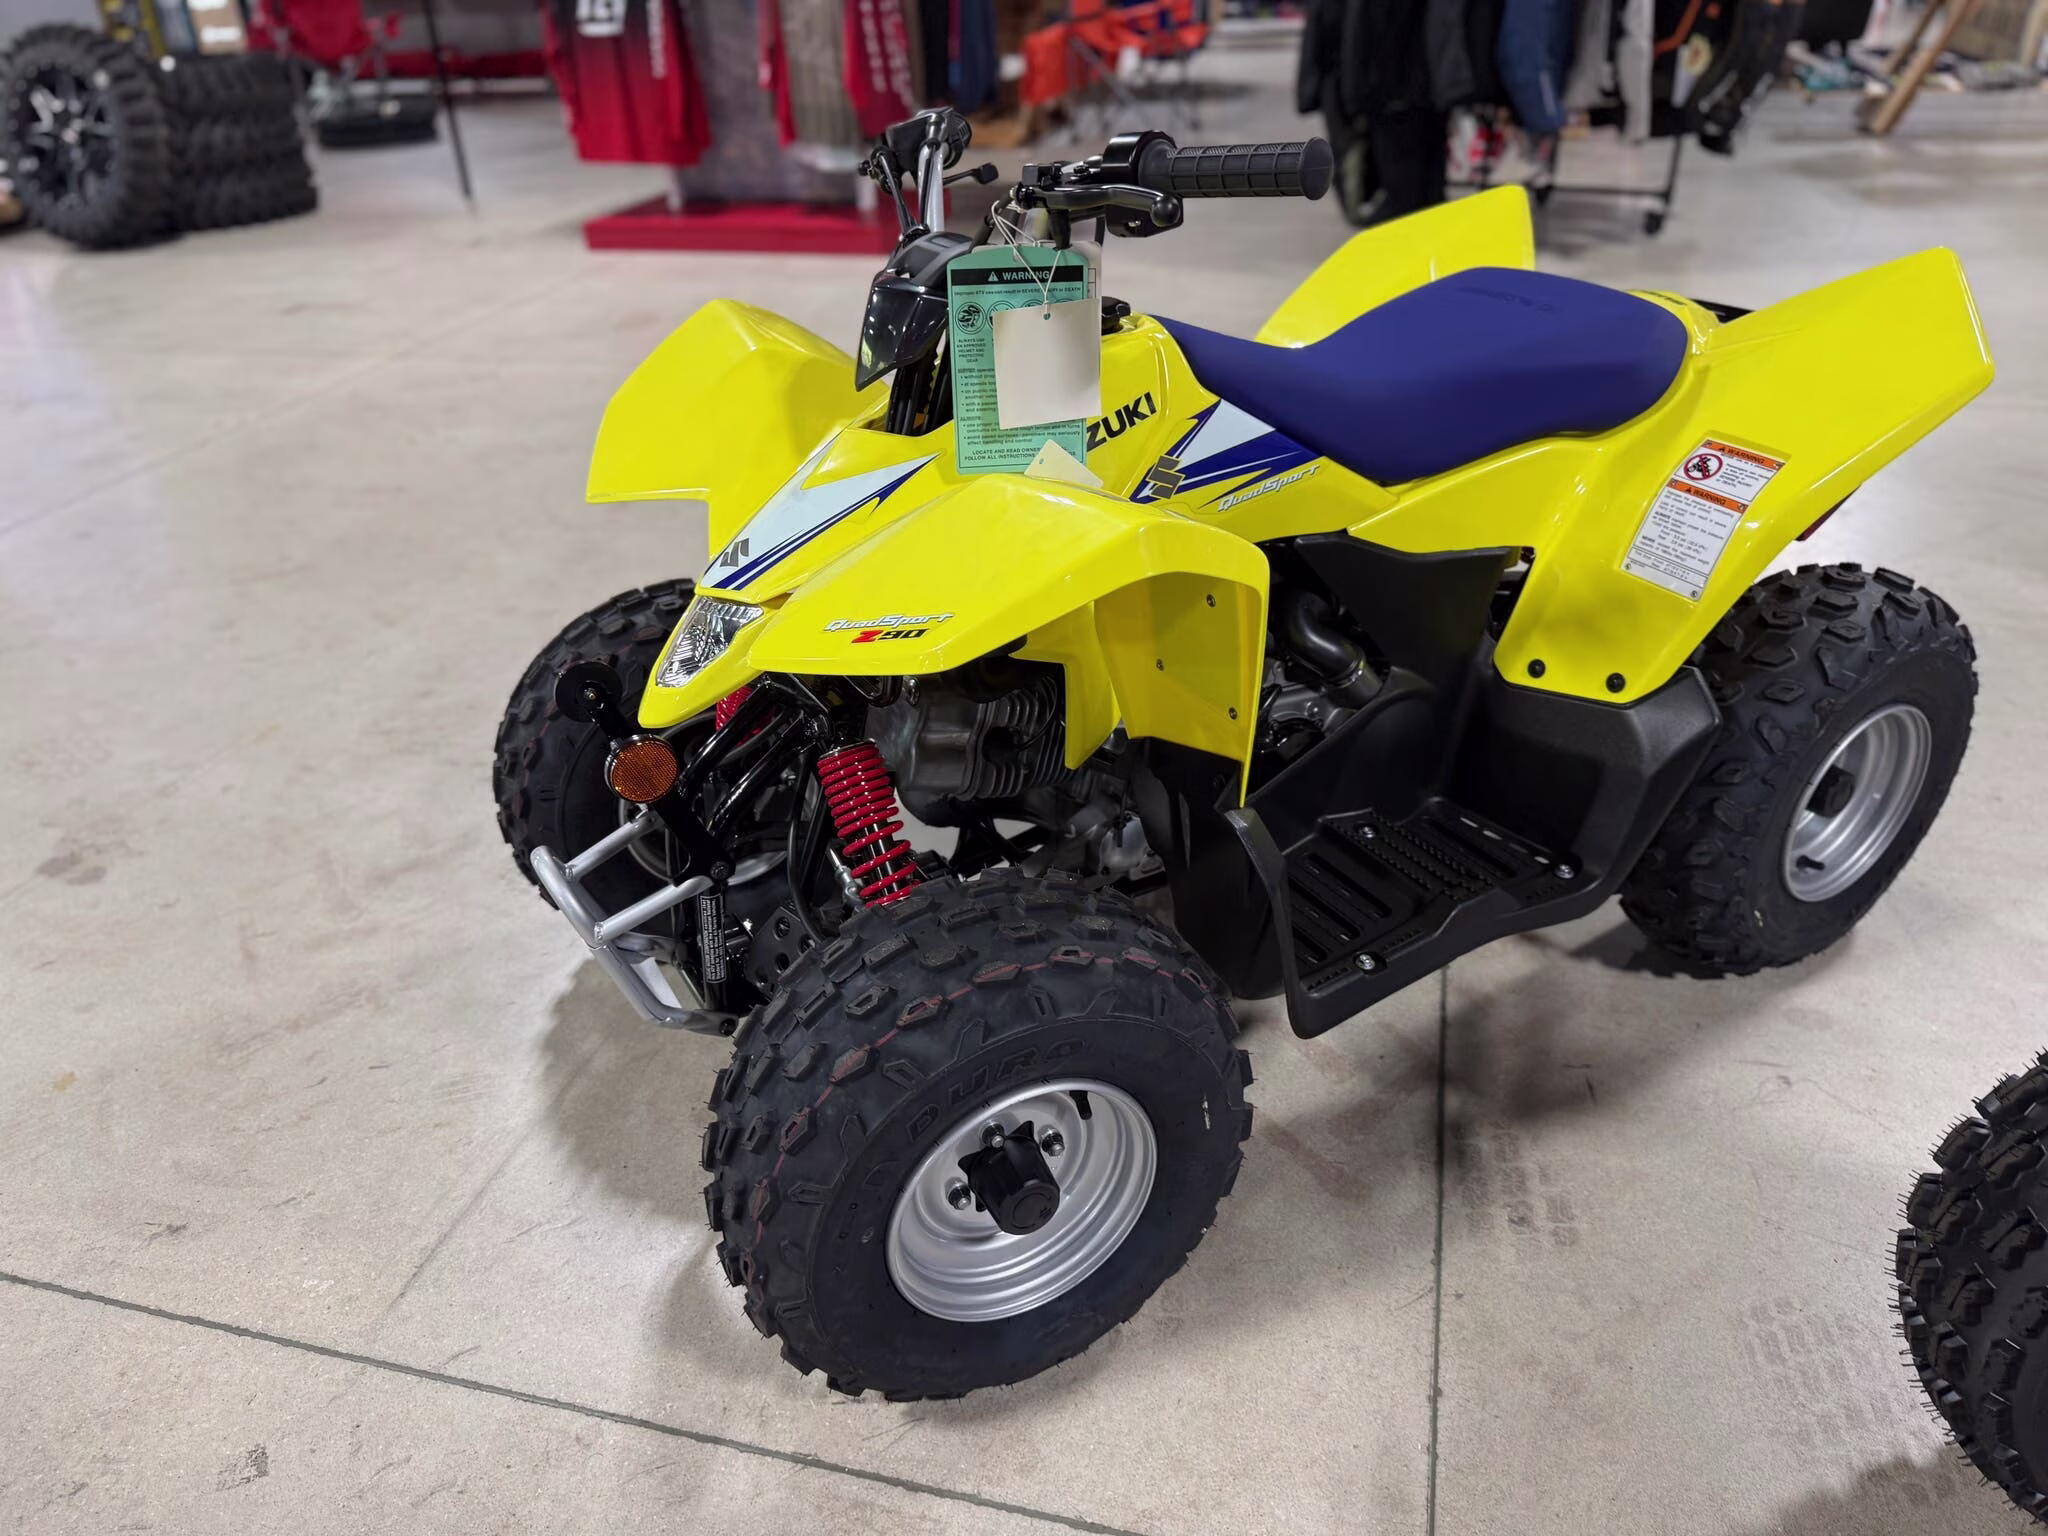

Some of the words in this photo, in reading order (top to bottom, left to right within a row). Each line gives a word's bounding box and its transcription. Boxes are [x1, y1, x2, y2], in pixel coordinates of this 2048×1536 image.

[1002, 270, 1050, 280] WARNING
[1087, 391, 1157, 451] ZUKI
[1728, 448, 1765, 464] WARNING
[1217, 465, 1320, 512] QuadSport
[1692, 489, 1726, 505] WARNING
[824, 612, 955, 632] QuadSport
[851, 628, 929, 644] Z90
